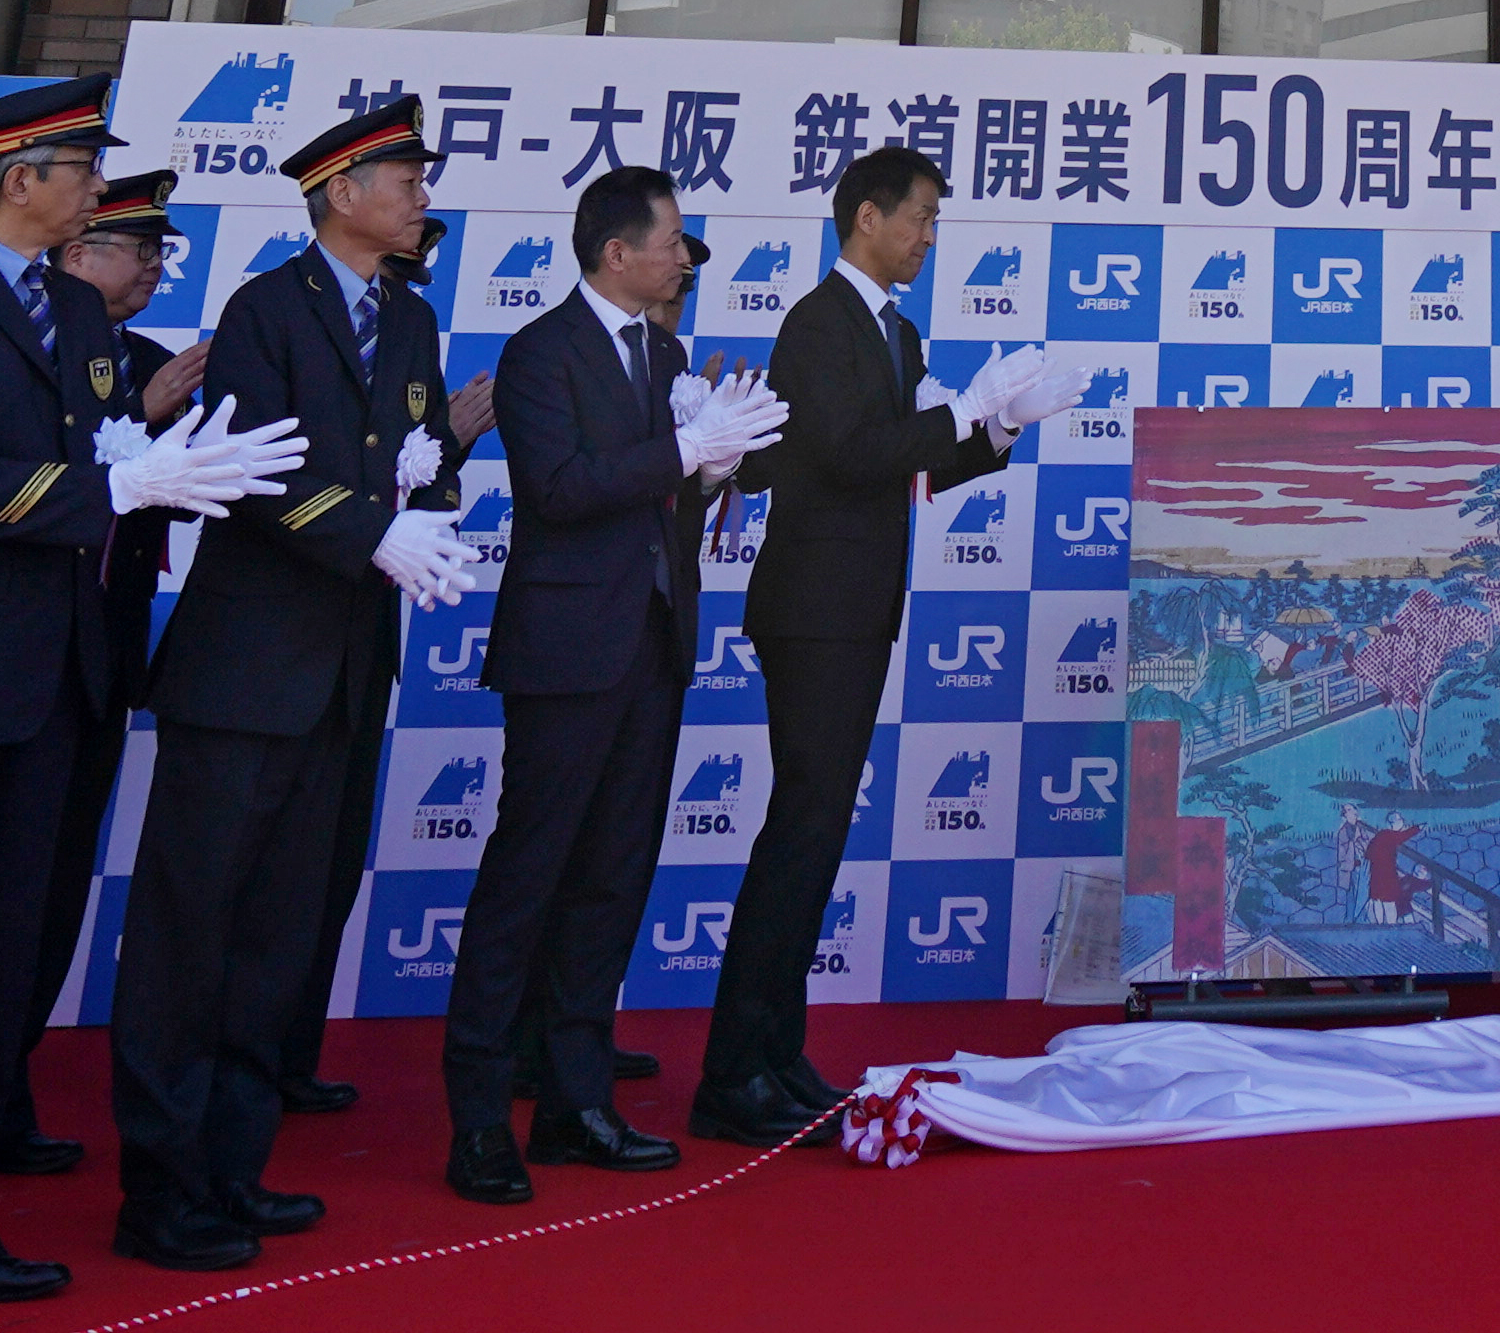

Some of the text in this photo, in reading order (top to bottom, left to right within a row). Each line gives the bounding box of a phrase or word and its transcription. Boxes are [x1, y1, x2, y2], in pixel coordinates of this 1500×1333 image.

[193, 144, 277, 175] 150th
[1069, 255, 1141, 295] JR
[1293, 258, 1362, 298] JR
[1077, 298, 1130, 310] JR西日本
[1301, 302, 1352, 313] JR西日本
[1056, 498, 1130, 541] JR
[1064, 545, 1116, 556] JR西日本
[928, 626, 1005, 671] JR
[937, 675, 992, 687] JR西日本
[1042, 757, 1117, 804] JR
[1050, 808, 1105, 821] JR西日本
[909, 897, 988, 946] JR
[917, 949, 974, 963] JR西日本
